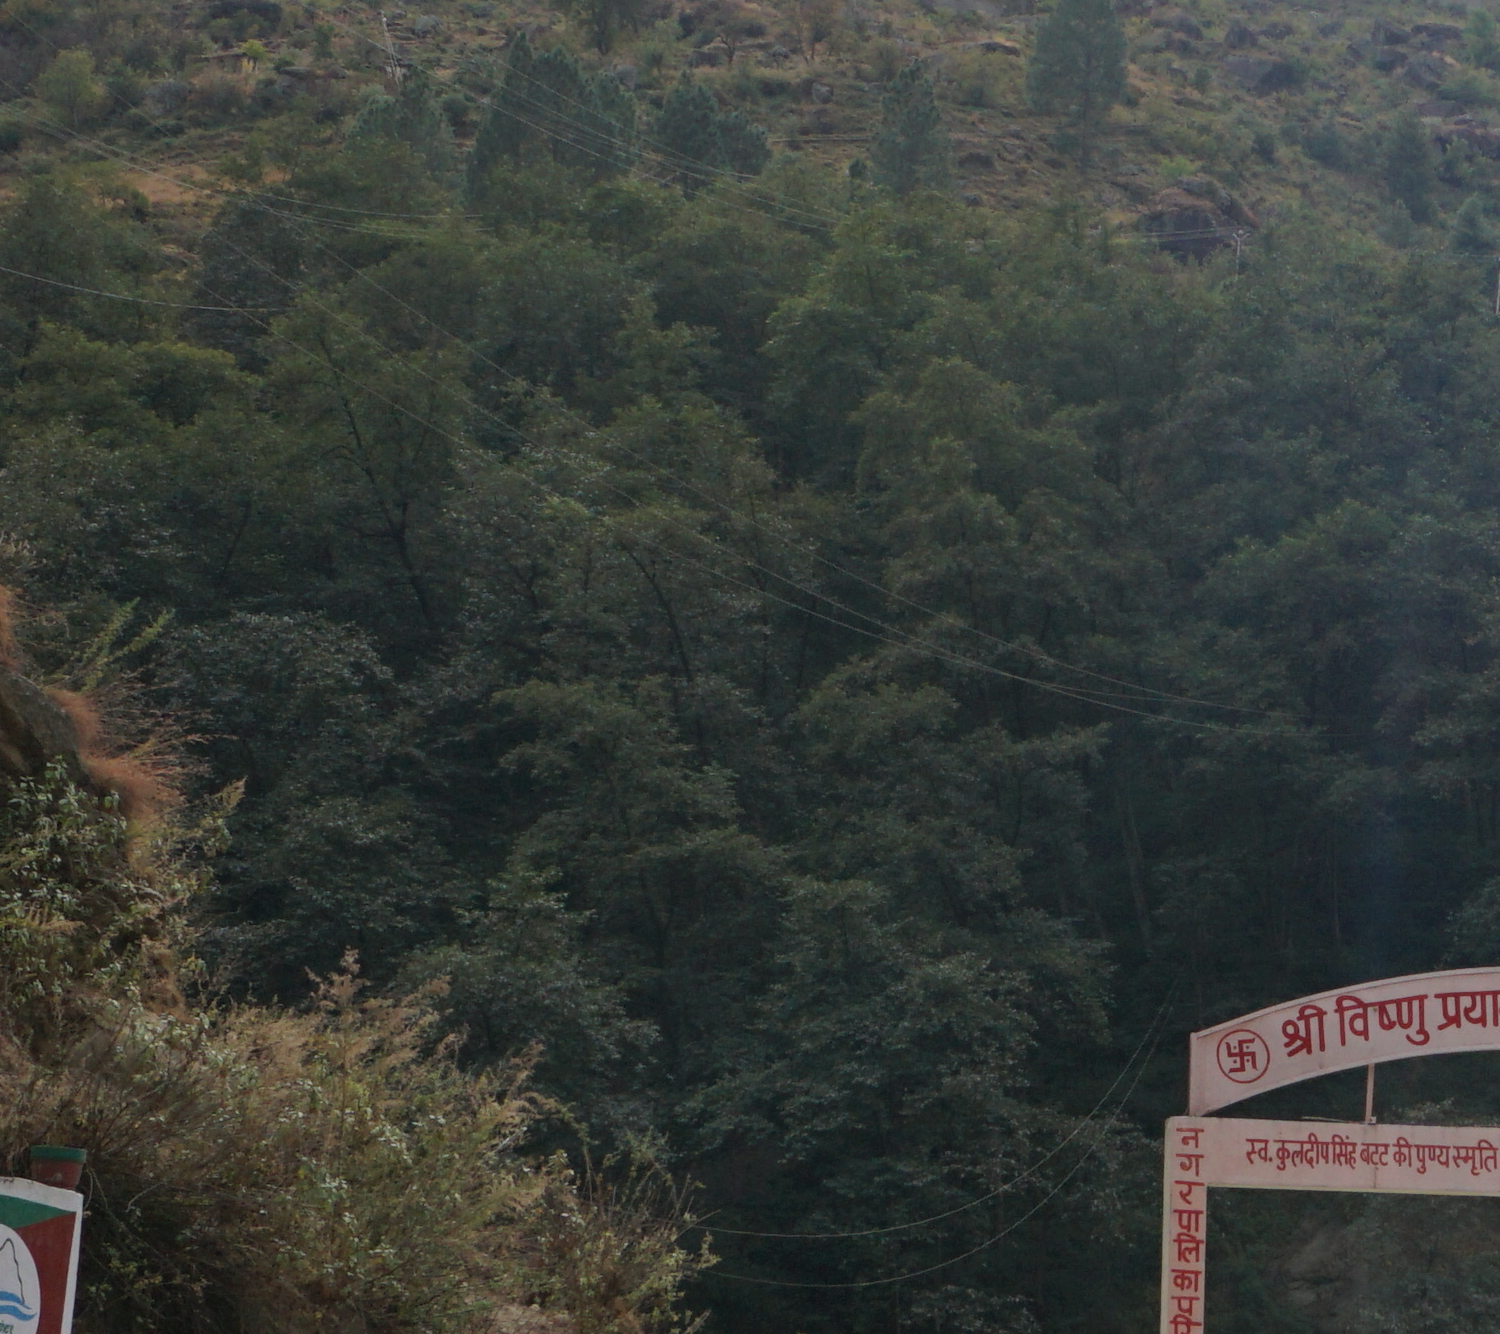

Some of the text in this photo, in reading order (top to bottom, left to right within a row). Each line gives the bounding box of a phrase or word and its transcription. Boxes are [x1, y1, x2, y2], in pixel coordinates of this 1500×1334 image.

[1282, 1005, 1327, 1058] श्री
[1334, 995, 1430, 1046] विष्णु
[1246, 1138, 1272, 1165] स्व.
[1273, 1132, 1330, 1170] कुलदीप
[1330, 1134, 1357, 1169] सिंह
[1392, 1136, 1416, 1168] की
[1415, 1143, 1451, 1175] पुण्य
[1452, 1139, 1498, 1176] स्मृति
